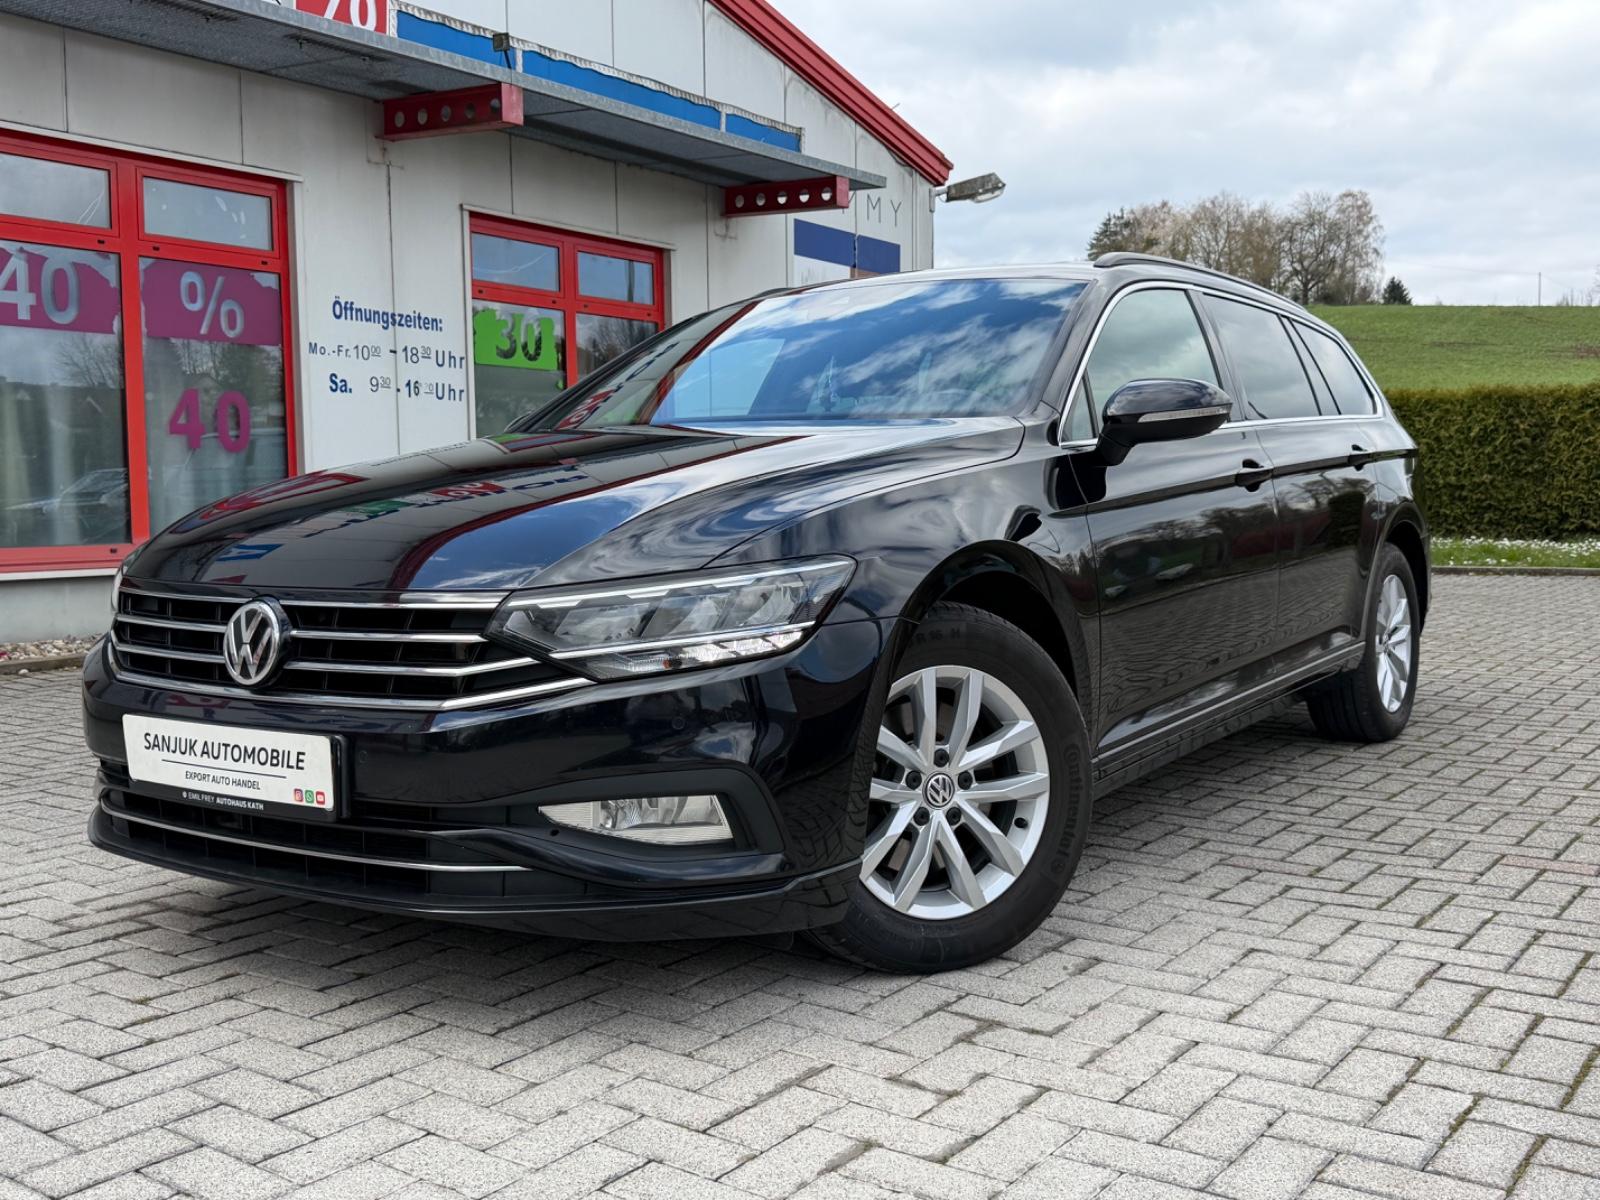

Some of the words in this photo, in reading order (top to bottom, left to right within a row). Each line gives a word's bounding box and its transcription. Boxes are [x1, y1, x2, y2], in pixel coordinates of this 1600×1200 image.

[0, 252, 79, 325] 40
[180, 270, 245, 338] %
[332, 295, 443, 332] Öffnungszeiten:
[495, 311, 542, 362] 30
[435, 349, 465, 369] Uhr
[329, 372, 353, 394] Sa.
[435, 382, 465, 402] Uhr
[169, 388, 250, 453] 40
[143, 732, 198, 758] SANJUK
[200, 740, 306, 771] AUTOMOBILE
[185, 770, 211, 783] EXPORT
[211, 775, 231, 786] AUTO
[231, 777, 261, 790] HANDEL
[216, 797, 247, 809] AUTOHAUS
